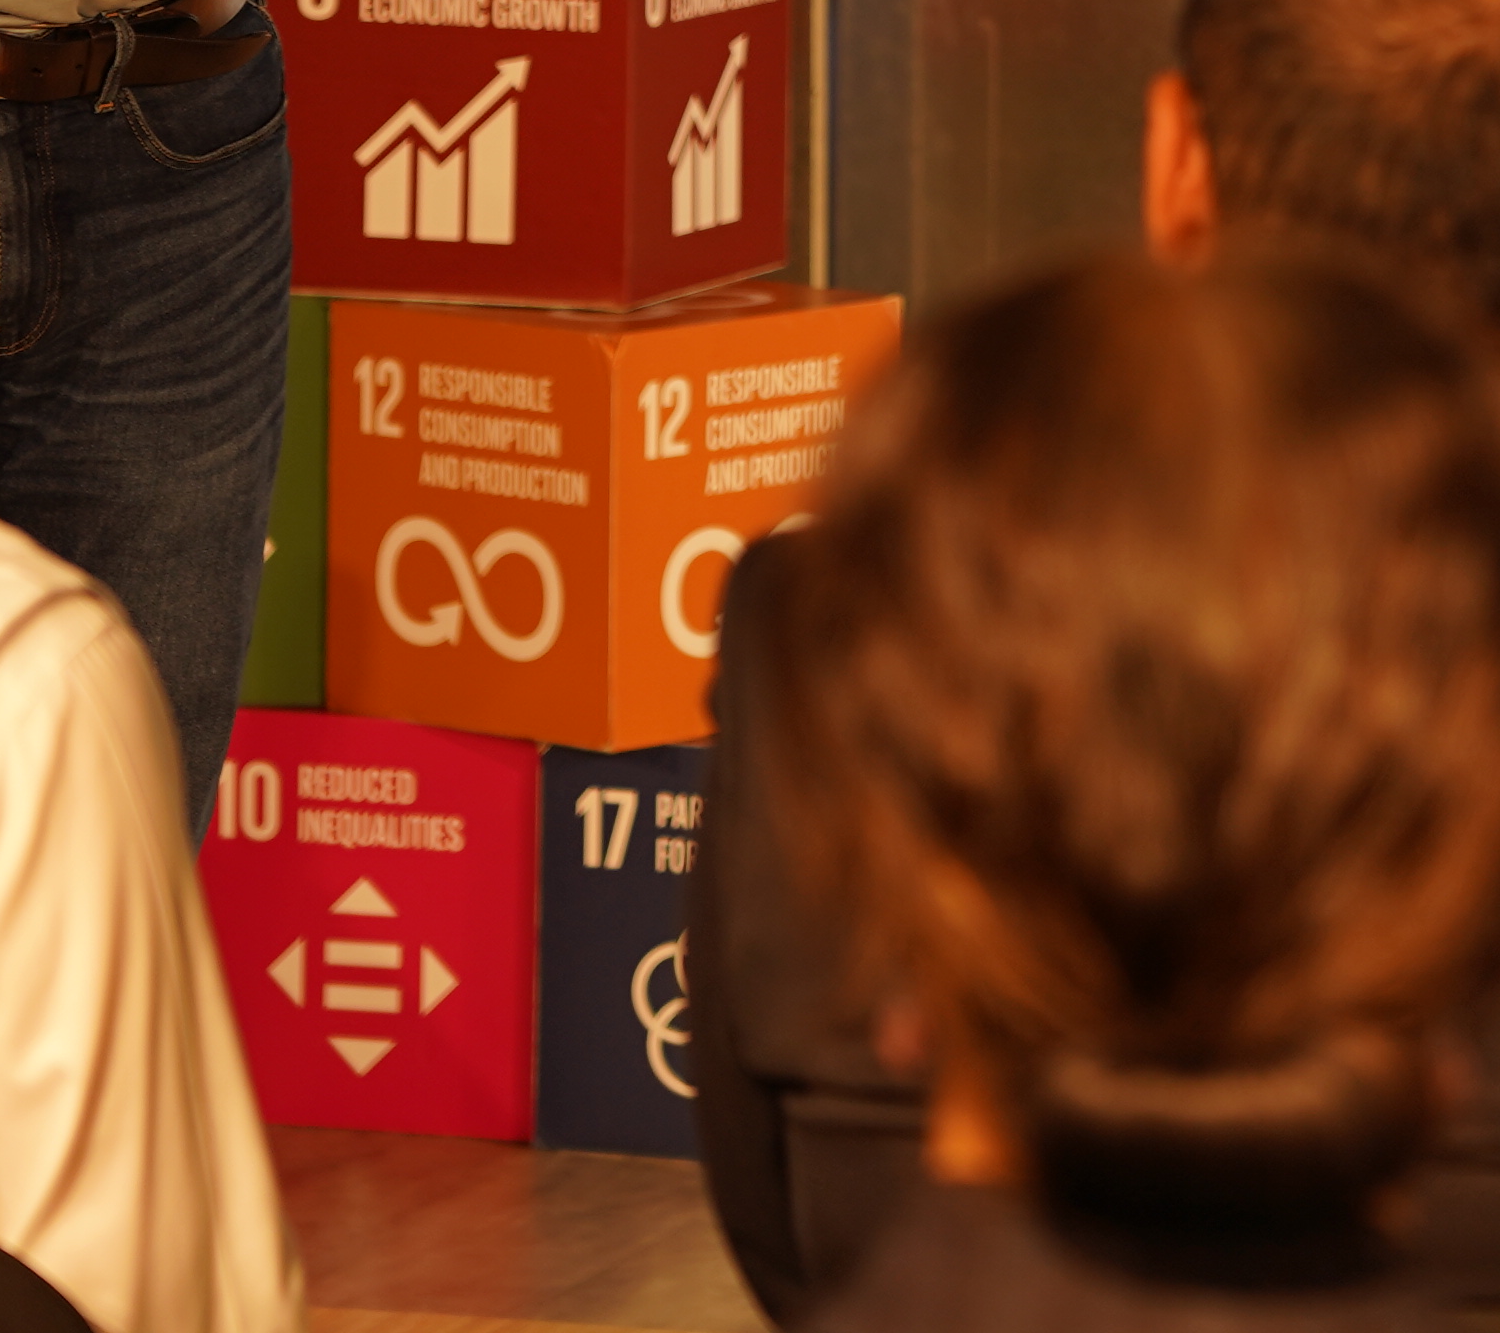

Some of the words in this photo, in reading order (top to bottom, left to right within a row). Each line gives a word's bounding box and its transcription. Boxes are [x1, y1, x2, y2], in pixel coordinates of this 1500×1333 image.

[353, 355, 405, 439] 12
[418, 362, 553, 413] RESPONSIBLE
[706, 352, 843, 408] RESPONSIBLE
[418, 406, 563, 459] CONSUMPTION
[637, 375, 692, 461] 12
[705, 396, 846, 452] CONSUMPTION
[418, 451, 460, 490] AND
[461, 456, 590, 507] PRODUCTION
[704, 457, 747, 496] AND
[218, 759, 281, 843] 10
[297, 763, 418, 805] REDUCED
[296, 808, 466, 853] INEQUALITIES
[575, 786, 639, 870] 17
